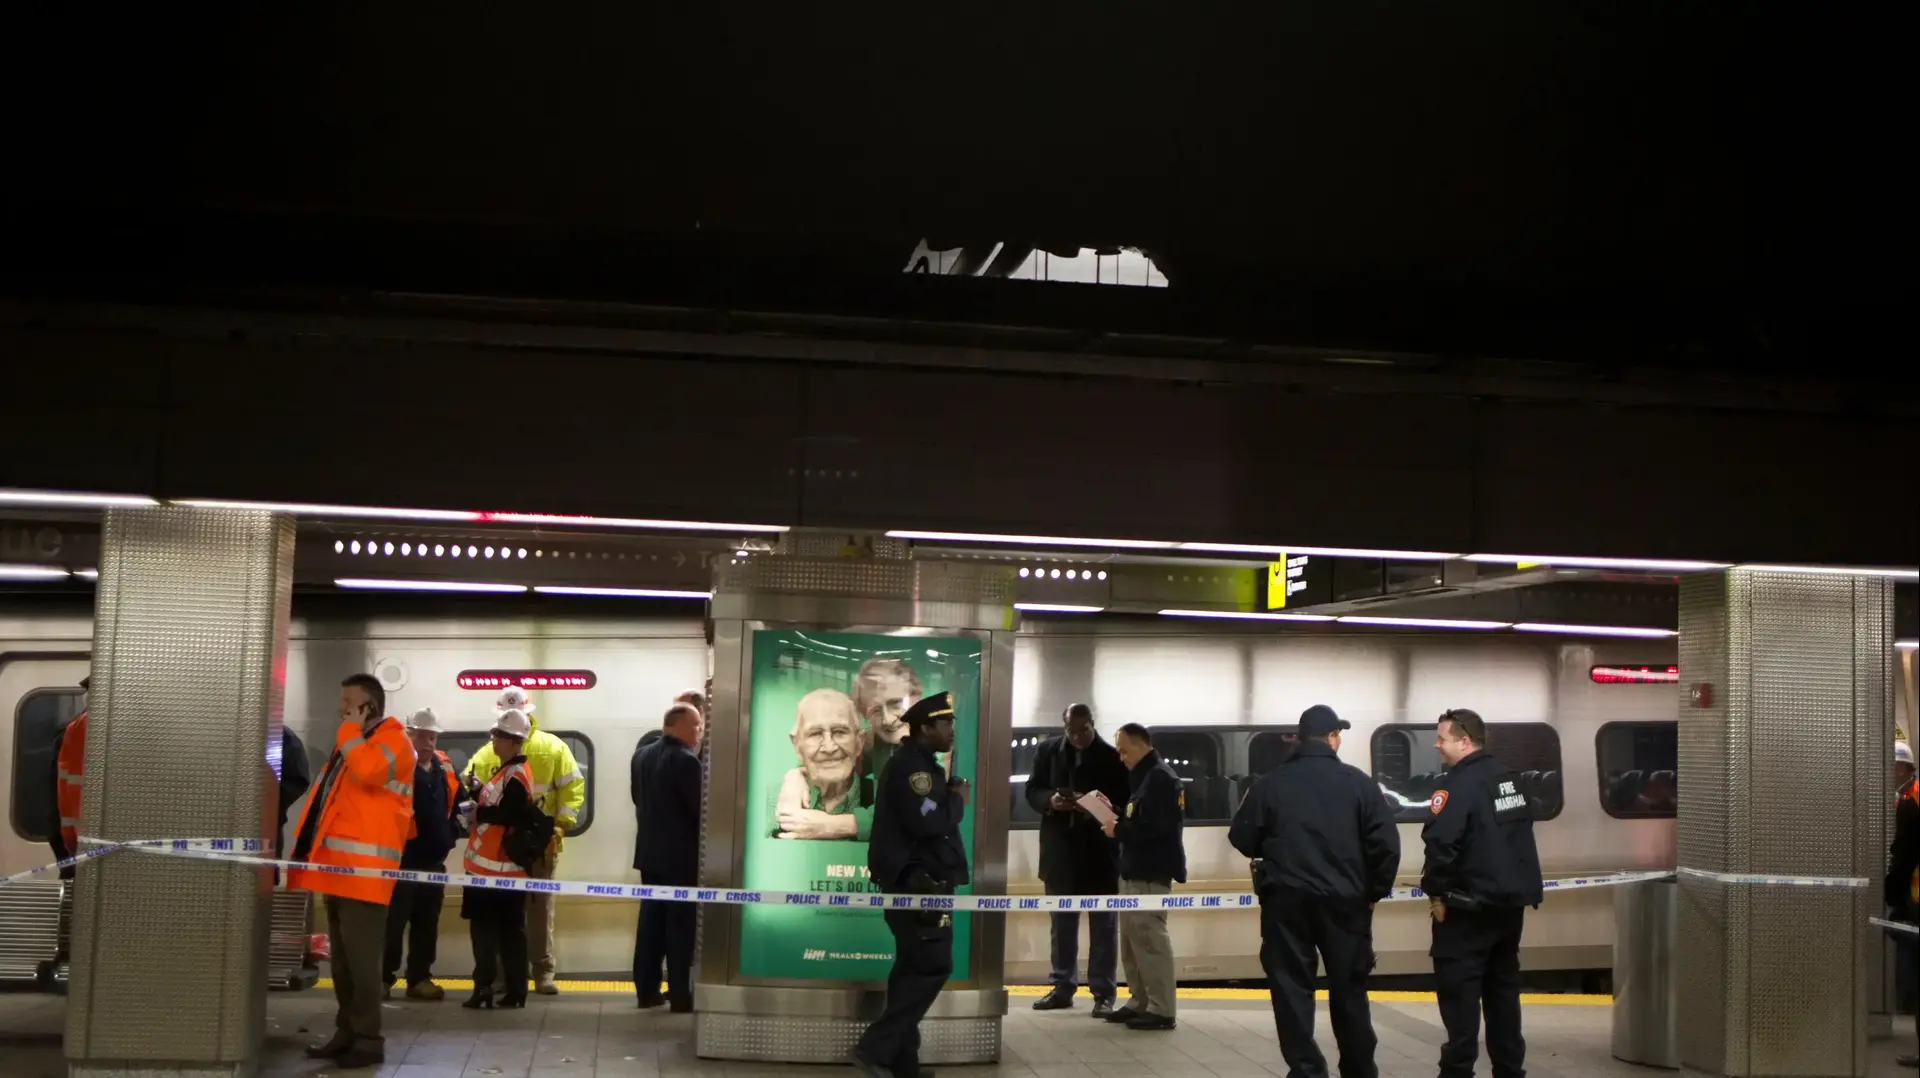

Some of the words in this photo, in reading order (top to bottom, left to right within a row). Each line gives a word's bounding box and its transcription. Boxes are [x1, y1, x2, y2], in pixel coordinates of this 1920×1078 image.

[1499, 781, 1516, 795] FIRE
[826, 864, 855, 877] NEW
[381, 870, 418, 880] POLICE
[428, 873, 449, 883] LINE
[471, 877, 486, 886] DO
[495, 879, 516, 888] NOT
[525, 880, 561, 891] CROSS
[587, 885, 623, 896] POLICE
[632, 888, 654, 897] LINE
[674, 889, 689, 899] DO
[697, 890, 719, 900] NOT
[726, 892, 761, 903] CROSS
[786, 894, 821, 905] POLICE
[829, 895, 850, 905] LINE
[869, 896, 884, 906] DO
[892, 897, 913, 907] NOT
[920, 897, 954, 908] CROSS
[978, 898, 1011, 909] POLICE
[1019, 899, 1040, 909] LINE
[1058, 898, 1072, 909] DO
[1080, 898, 1099, 908] NOT
[1106, 898, 1139, 908] CROSS
[1162, 897, 1194, 907] POLICE
[1201, 896, 1221, 906] LINE
[1239, 895, 1252, 905] DO
[810, 880, 843, 892] LET'S
[847, 881, 863, 893] DO
